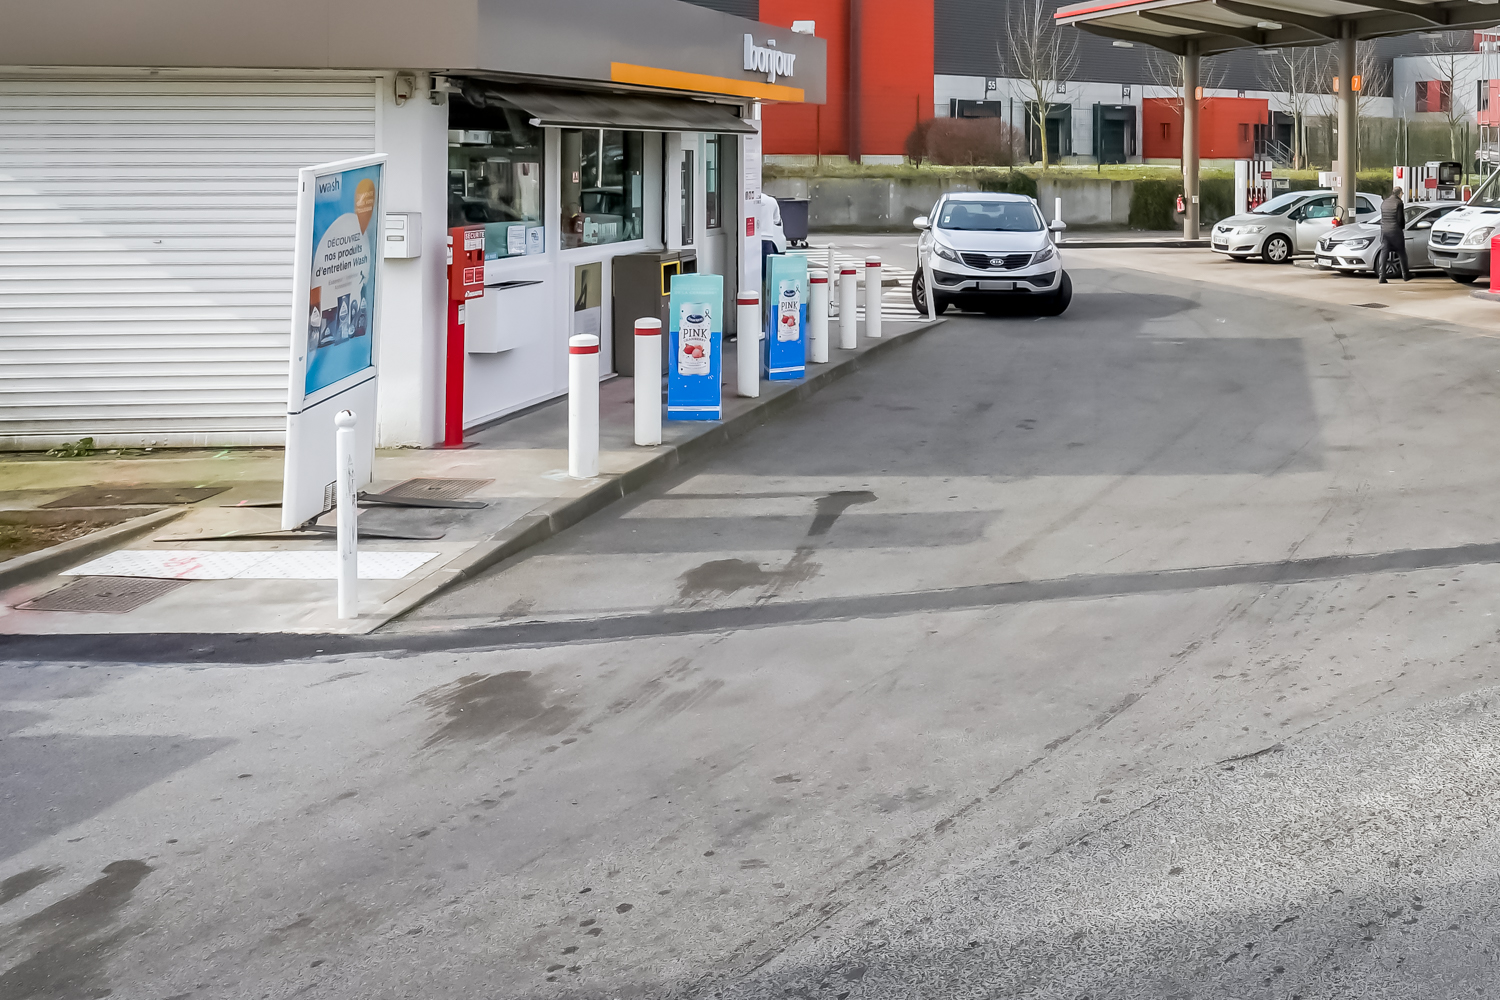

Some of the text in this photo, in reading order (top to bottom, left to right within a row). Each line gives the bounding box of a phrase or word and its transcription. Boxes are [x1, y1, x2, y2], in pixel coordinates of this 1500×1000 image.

[744, 33, 796, 84] bonjour
[987, 80, 996, 90] 55
[1057, 83, 1066, 93] 56
[1353, 77, 1359, 88] 7
[318, 177, 340, 194] wash
[327, 232, 361, 249] DÉCOUVREZ
[324, 244, 363, 262] nos produits
[315, 255, 368, 278] d'entretien Wash
[781, 301, 798, 311] PINK
[683, 328, 708, 339] PINK
